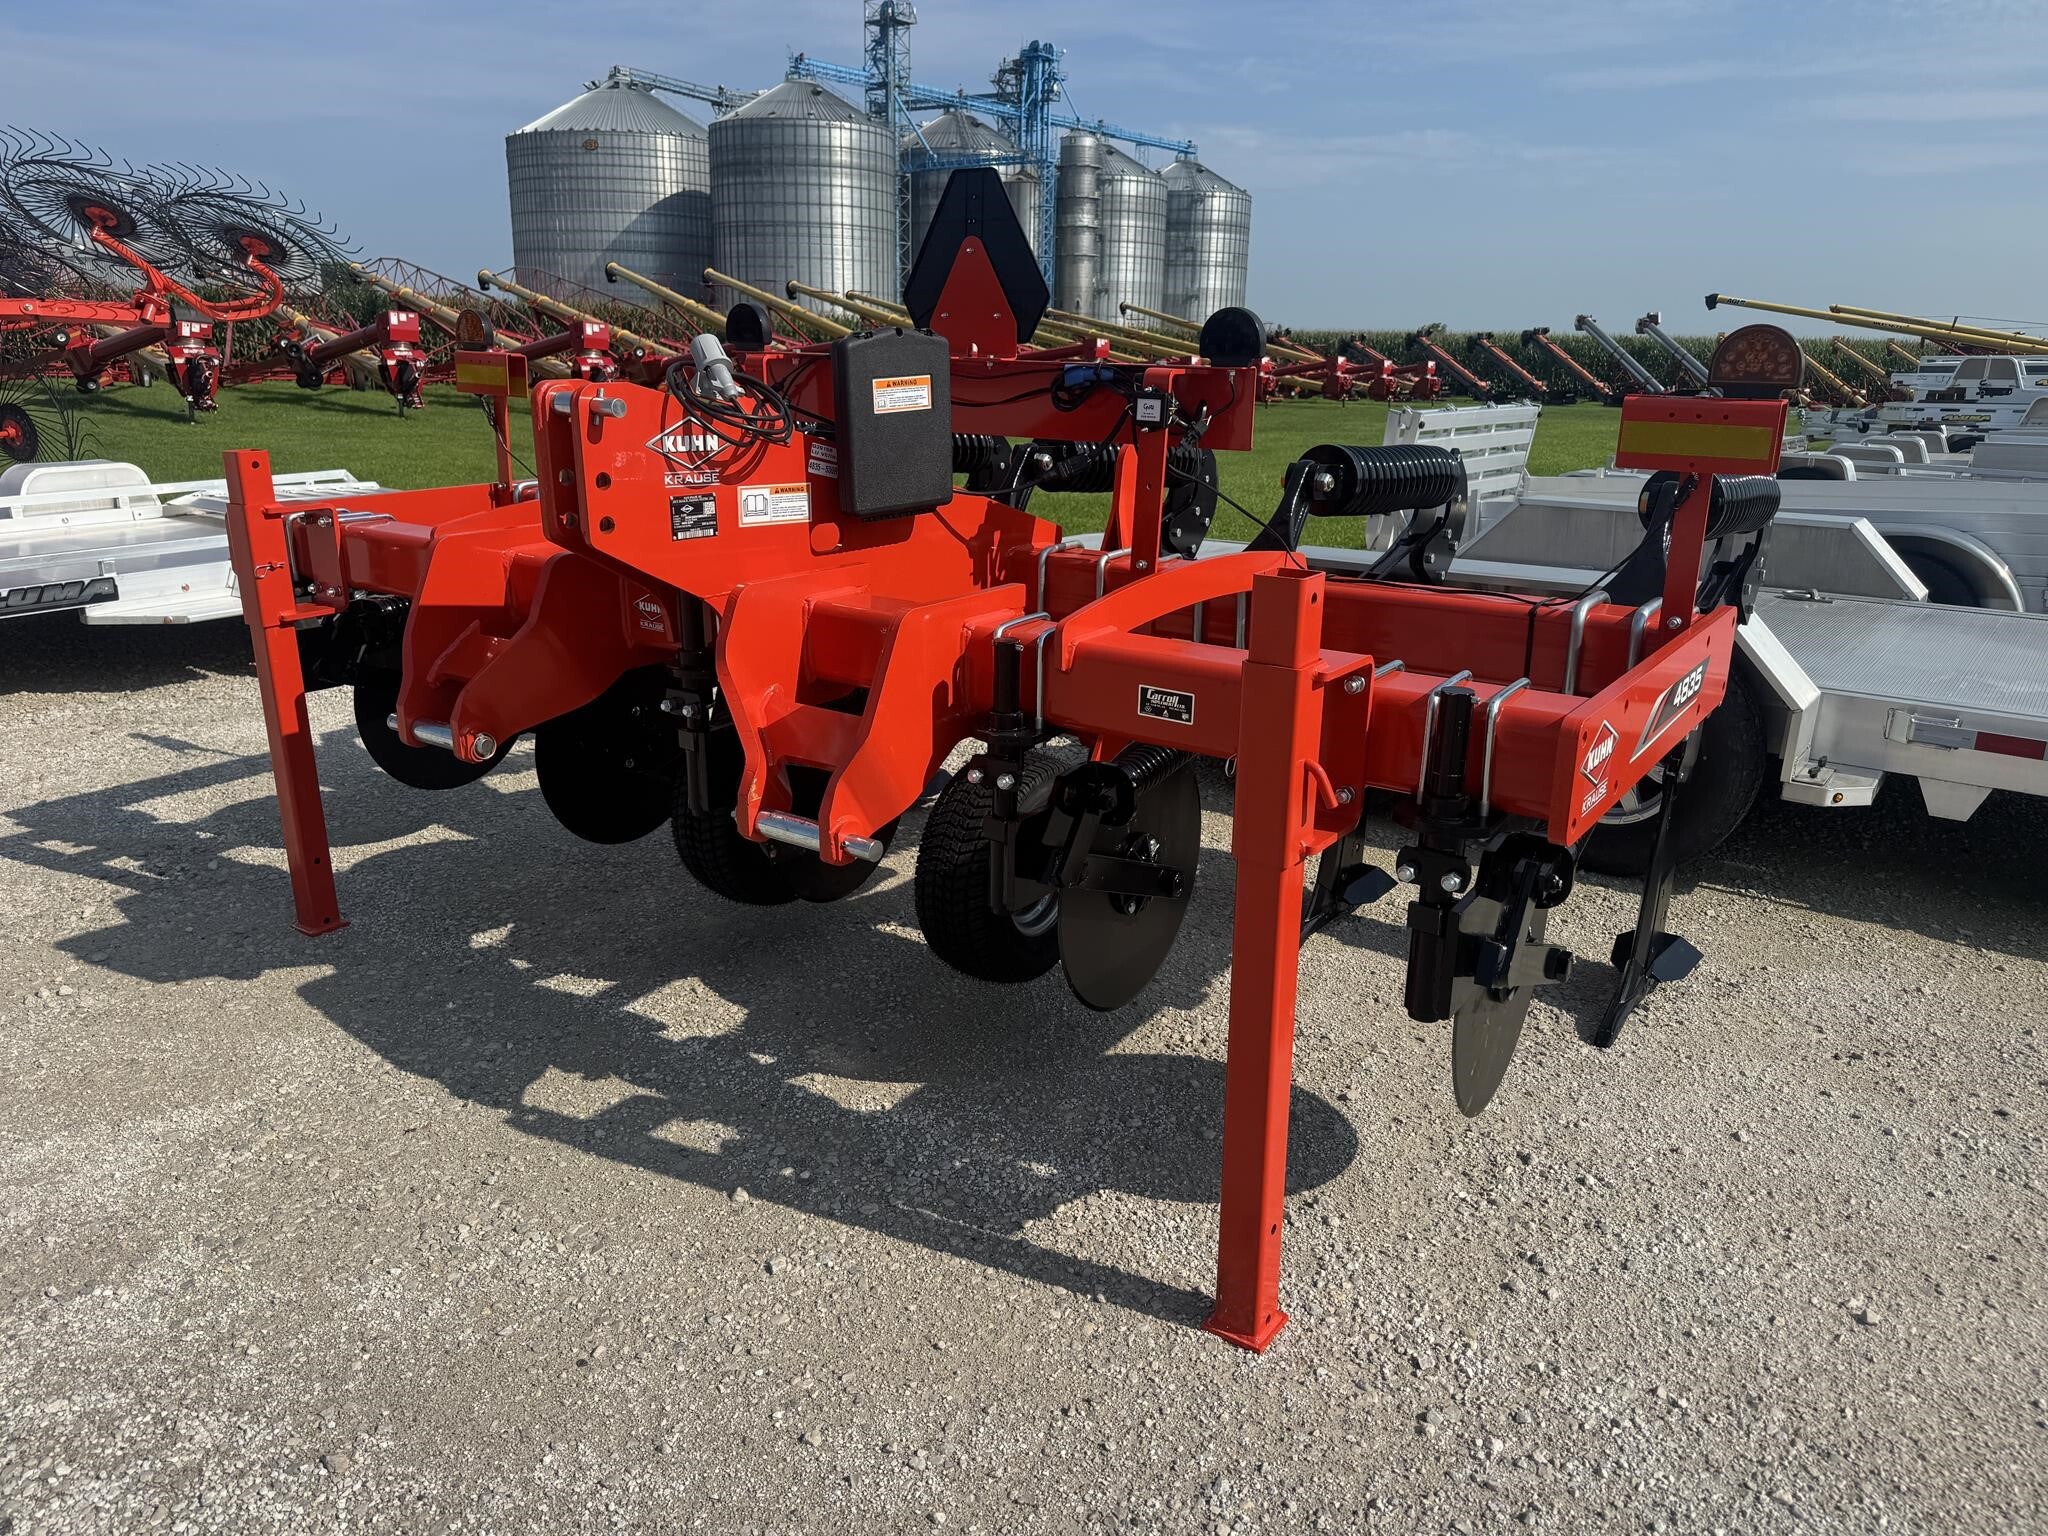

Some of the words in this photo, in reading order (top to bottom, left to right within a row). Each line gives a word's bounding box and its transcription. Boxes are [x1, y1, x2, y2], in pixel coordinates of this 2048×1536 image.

[892, 379, 918, 387] WARNING
[662, 435, 719, 453] KUHN
[664, 473, 720, 485] KRAUSE
[1673, 665, 1704, 707] 4835
[1147, 688, 1179, 708] Carroll
[1587, 733, 1614, 773] KUHN
[1582, 783, 1607, 812] KRAUSE
